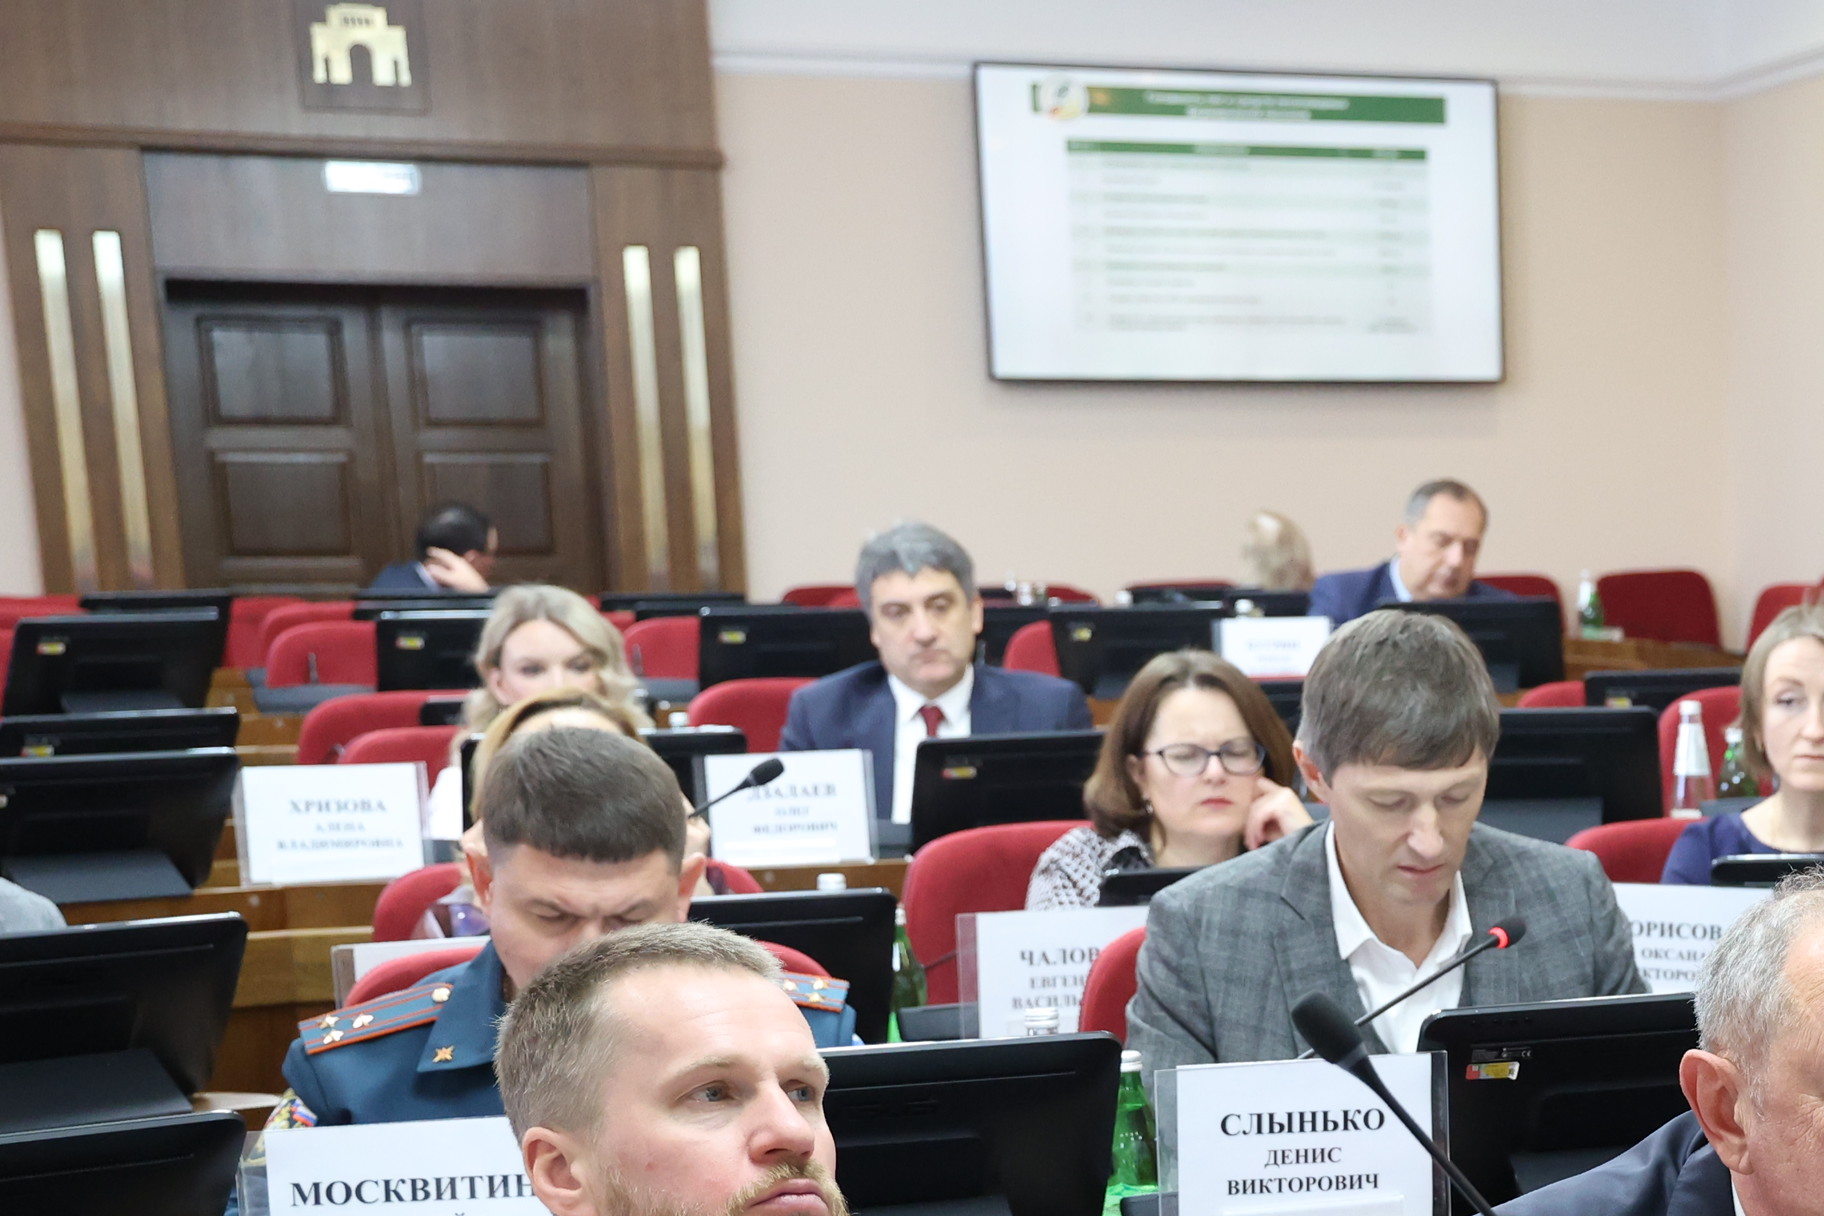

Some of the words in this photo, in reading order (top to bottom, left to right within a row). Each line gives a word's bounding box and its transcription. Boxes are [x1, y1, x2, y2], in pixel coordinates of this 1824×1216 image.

[1631, 919, 1723, 941] ОРИСОВ
[1019, 946, 1100, 967] ЧАЛОВ
[1640, 946, 1706, 962] ОКСАН
[1029, 974, 1086, 989] ЕВГЕН
[1641, 968, 1697, 982] КТОРО
[1012, 994, 1081, 1010] ВАСИЛЬ
[1219, 1107, 1386, 1137] СЛЫНЬКО
[1263, 1146, 1343, 1169] ДЕНИС
[290, 1172, 536, 1208] МОСКВИТИН
[1226, 1172, 1380, 1196] ВИКТОРОВИЧ
